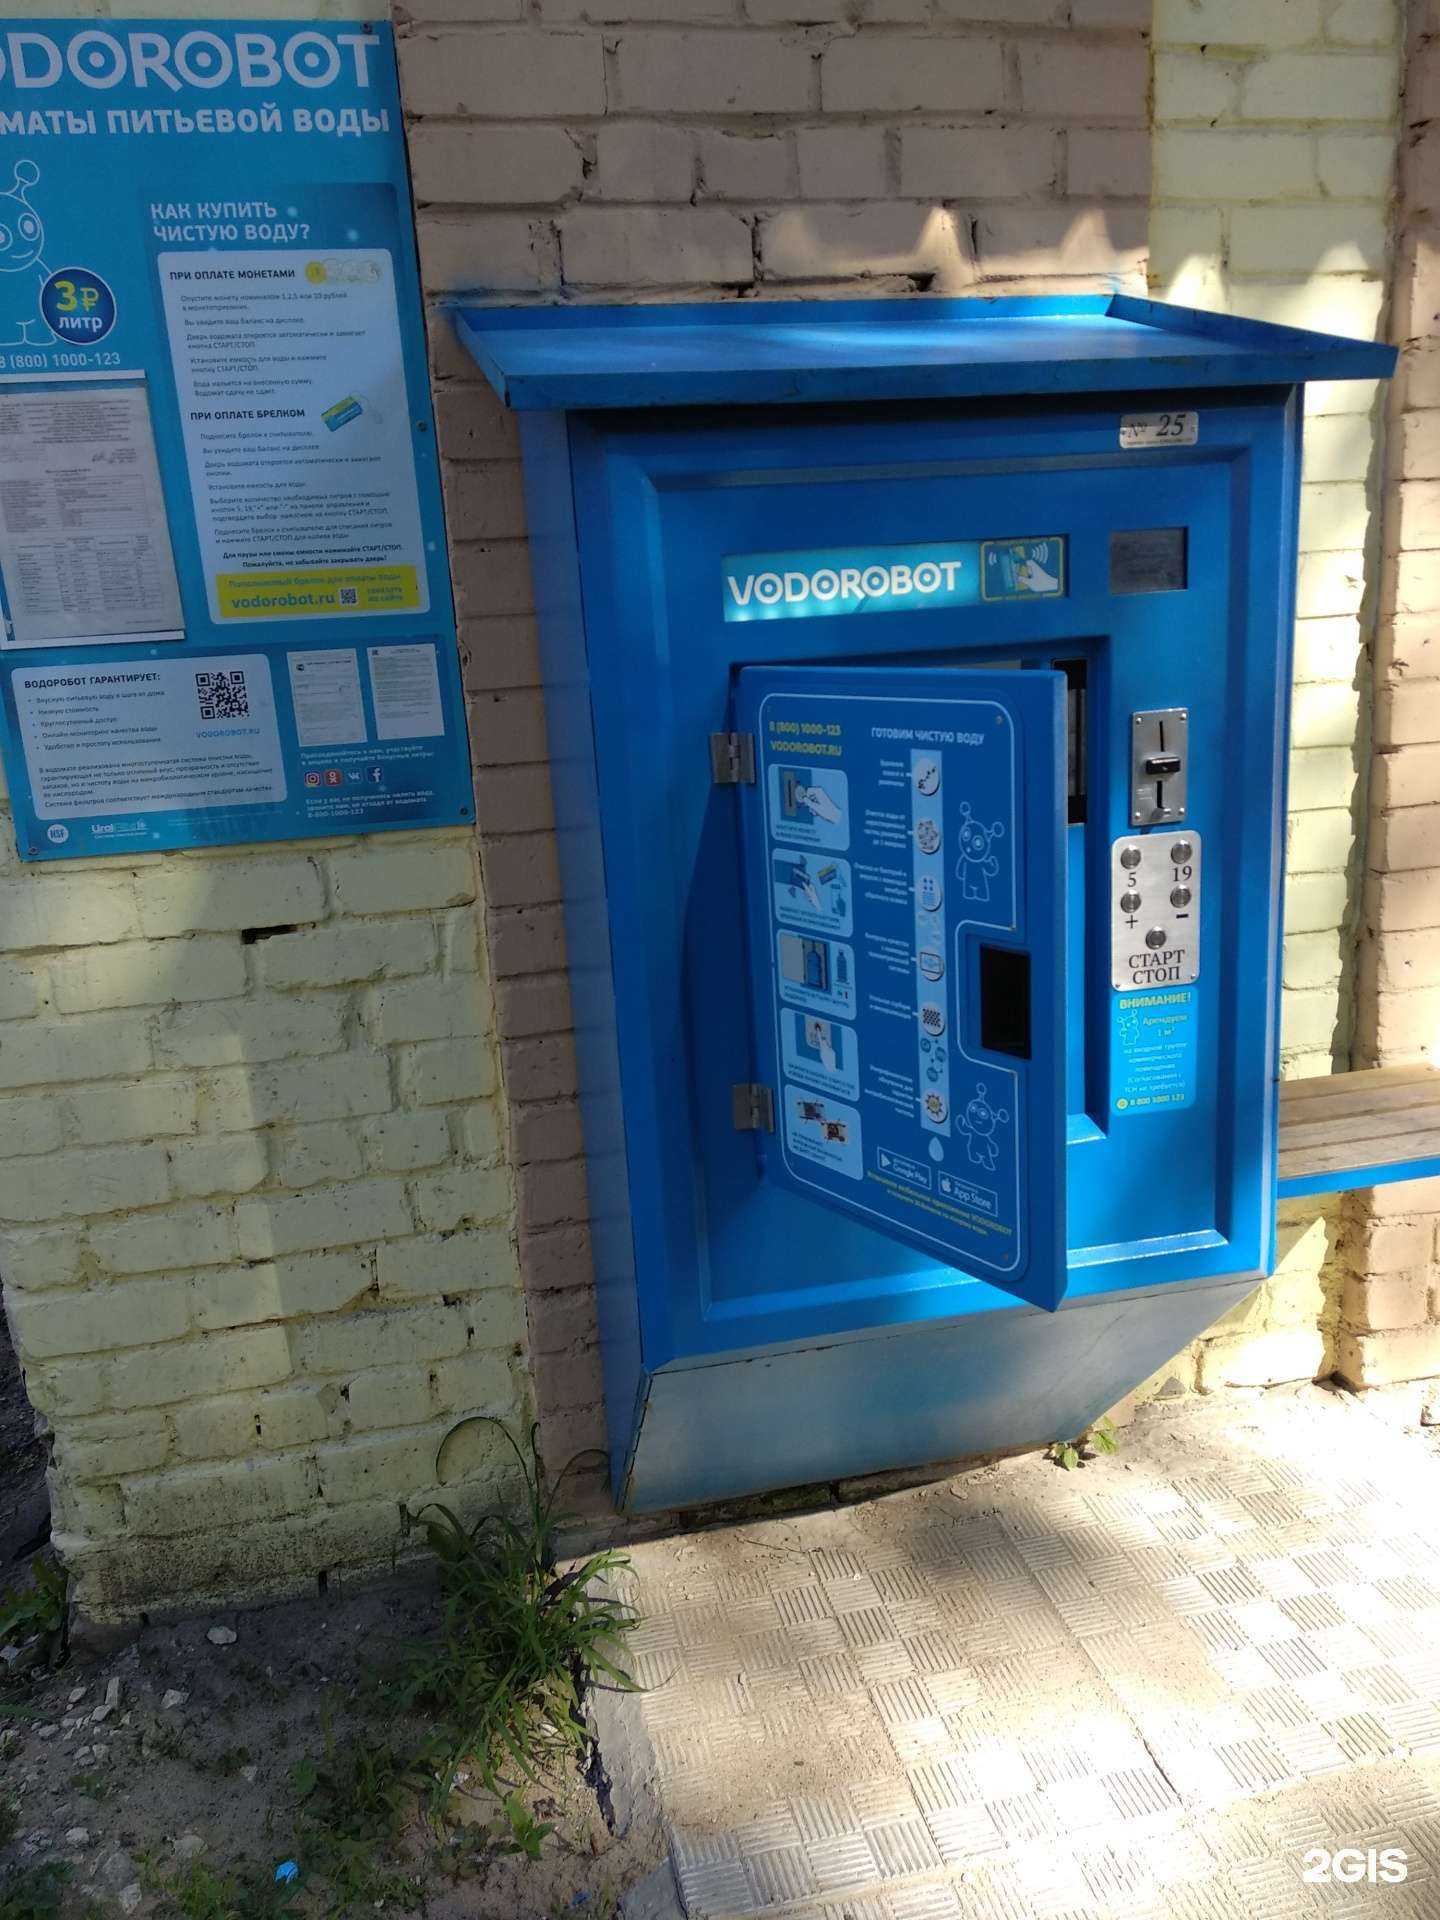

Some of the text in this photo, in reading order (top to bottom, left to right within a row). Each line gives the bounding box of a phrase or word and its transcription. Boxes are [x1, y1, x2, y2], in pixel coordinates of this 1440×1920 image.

[0, 29, 380, 92] DOROBOT
[108, 102, 283, 135] ПИТЬЕВОЙ
[294, 107, 390, 137] ВОДЫ
[150, 201, 277, 220] КАК КУПИТЬ
[153, 222, 311, 243] ЧИСТУЮ ВОДУ?
[169, 269, 296, 281] ПРИ ОПЛАТЕ МОНЕТАМИ
[59, 316, 103, 333] литр
[10, 353, 48, 369] (800)
[52, 351, 121, 368] 1000-123
[190, 408, 306, 421] ПРИ ОПЛАТЕ БРЕЛКОМ
[1156, 413, 1187, 437] 25
[727, 560, 962, 607] VODOROBOT
[231, 591, 336, 610] vodorobot.ru
[24, 671, 161, 690] ВОДОРОБОТ ГАРАНТИРУЕТ:
[870, 726, 985, 747] ГОТОВИМ ЧИСТУЮ ВОДУ
[1126, 865, 1193, 888] 5 19
[1128, 949, 1185, 969] СТАРТ
[1132, 966, 1180, 985] СТОП
[1119, 991, 1192, 1010] ВНИМАНИЕ!
